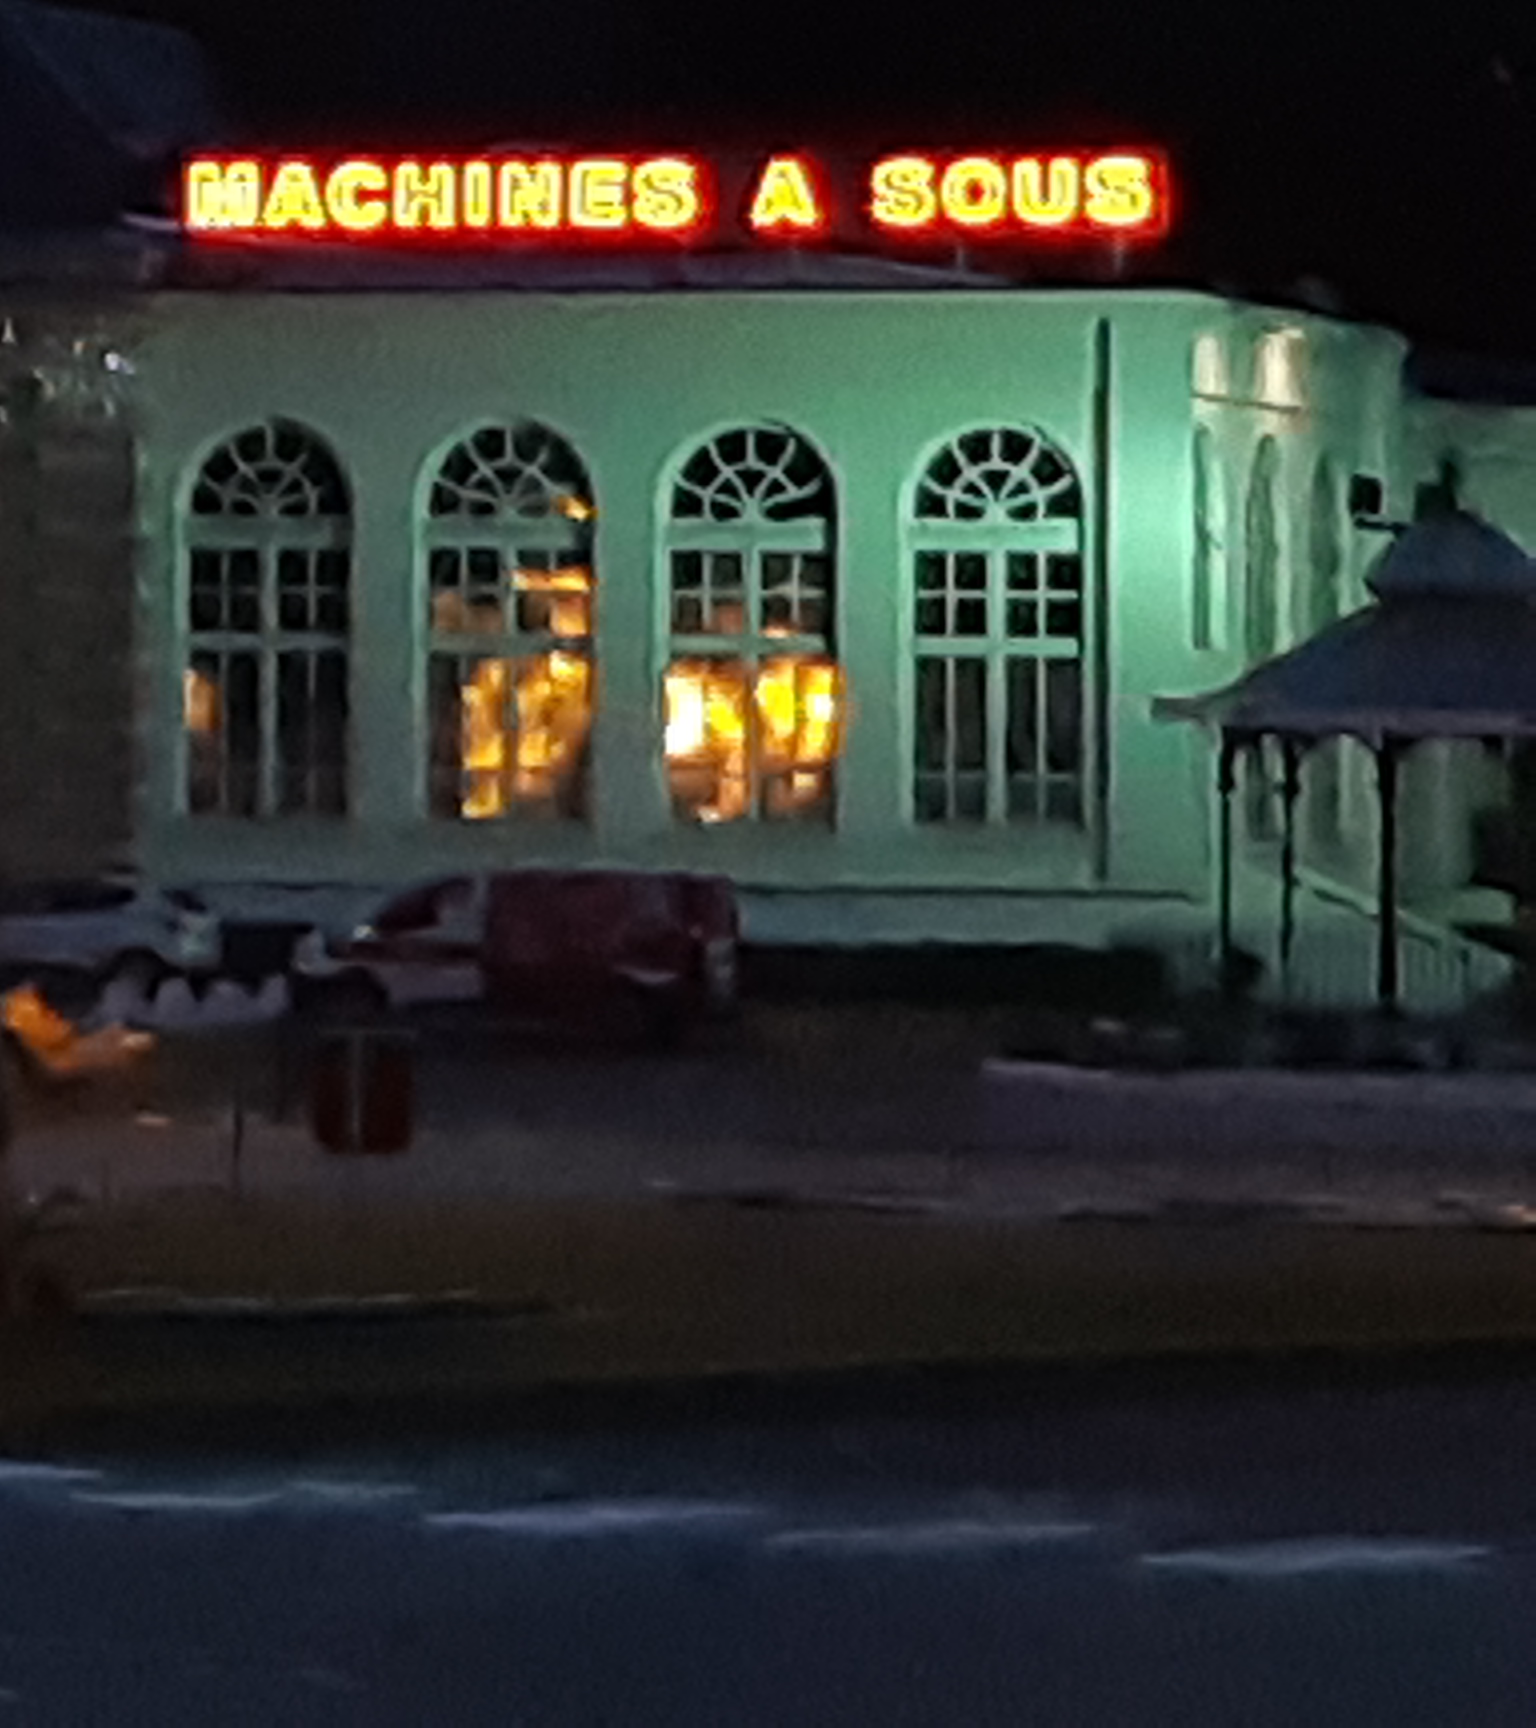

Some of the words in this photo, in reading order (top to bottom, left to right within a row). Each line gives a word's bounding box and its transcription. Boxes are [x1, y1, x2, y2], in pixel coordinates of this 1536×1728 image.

[185, 157, 699, 230] MACHINES
[748, 159, 821, 227] A
[869, 155, 1155, 228] SOUS
